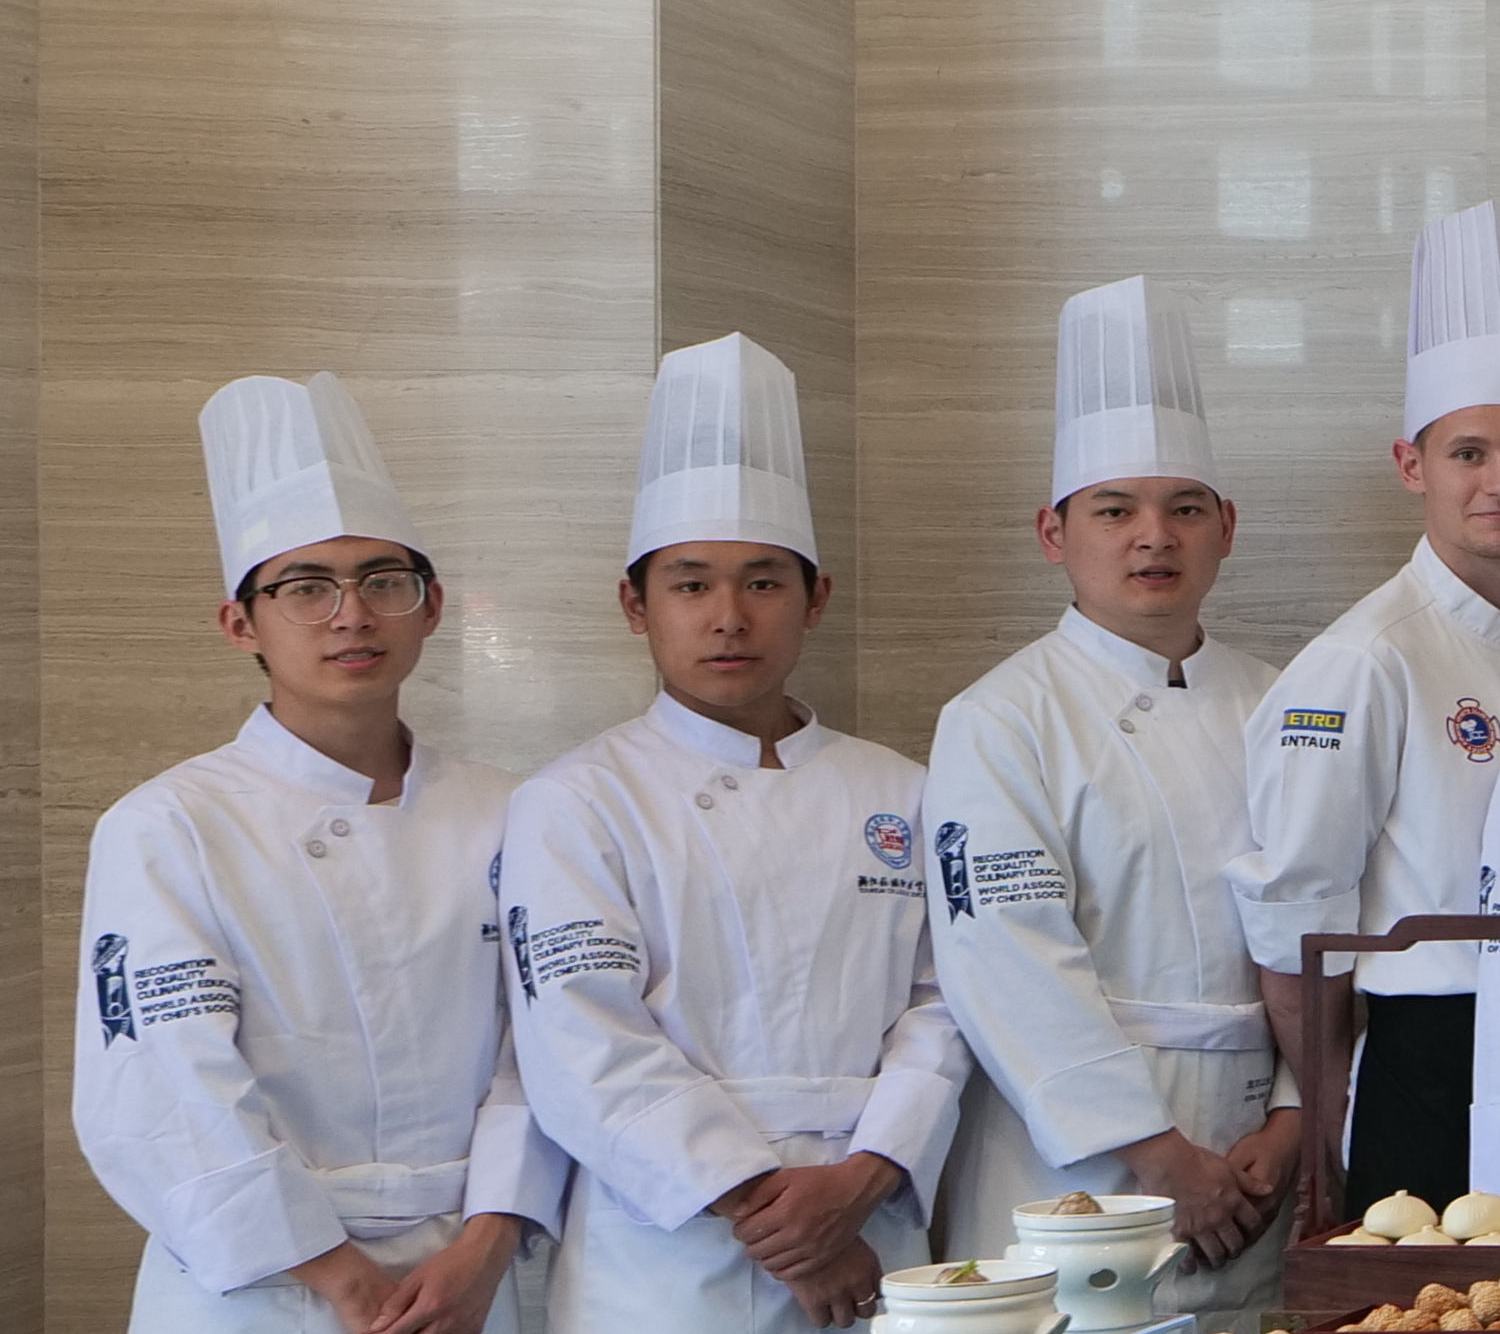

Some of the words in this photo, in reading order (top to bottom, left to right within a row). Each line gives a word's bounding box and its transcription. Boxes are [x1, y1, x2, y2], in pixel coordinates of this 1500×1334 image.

[1287, 713, 1340, 728] ETRO
[972, 850, 1045, 864] RECOGNITION
[973, 863, 989, 873] OF
[990, 859, 1036, 872] QUALITY
[975, 870, 1028, 884] CULINARY
[977, 882, 1020, 897] WORLD
[979, 895, 996, 906] OF
[530, 919, 605, 942] RECOGNITION
[532, 940, 547, 953] OF
[548, 928, 595, 949] QUALITY
[533, 942, 584, 961] CULINARY
[134, 958, 217, 980] RECOGNITION
[537, 955, 577, 973] WORLD
[135, 977, 151, 990] OF
[152, 969, 206, 987] QUALITY
[538, 972, 553, 985] OF
[136, 985, 191, 1001] CULINARY
[140, 998, 187, 1015] WORLD
[142, 1014, 158, 1027] OF
